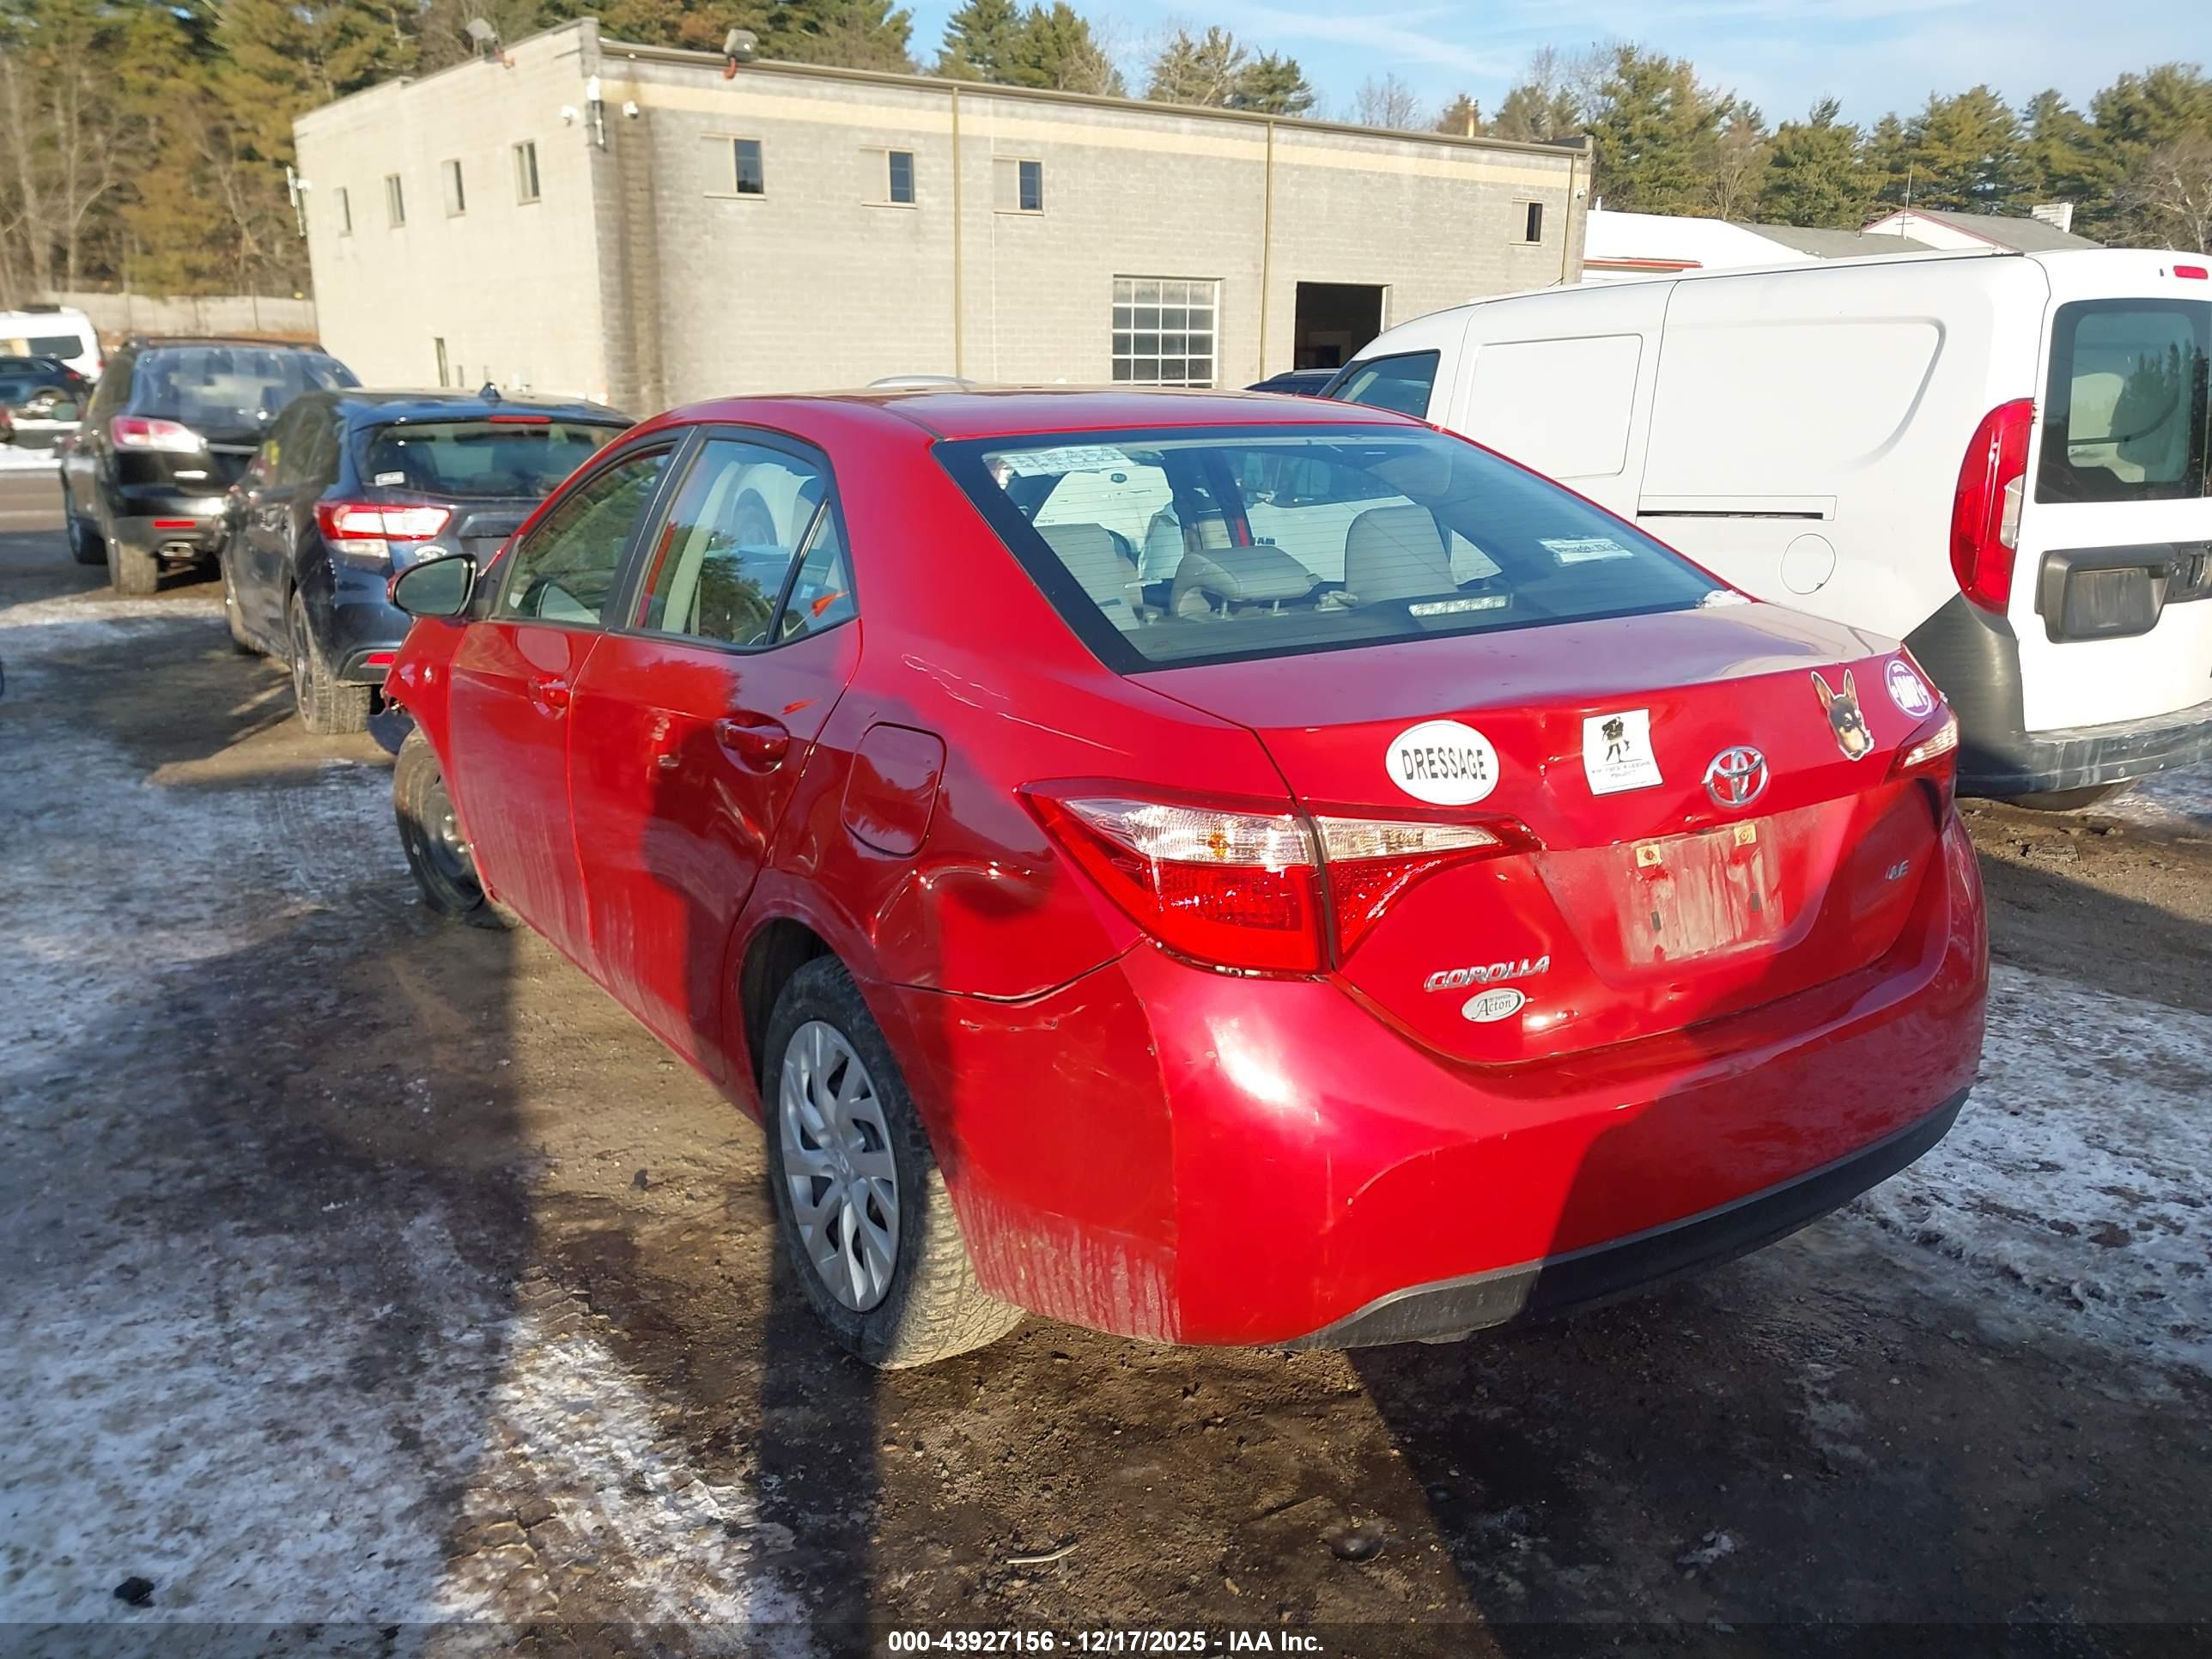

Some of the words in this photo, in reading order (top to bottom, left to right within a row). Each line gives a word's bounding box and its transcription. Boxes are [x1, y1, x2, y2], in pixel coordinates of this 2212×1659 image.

[1401, 746, 1487, 781] DRESSAGE
[1424, 955, 1551, 993] COROLLA
[1471, 998, 1511, 1019] Acton
